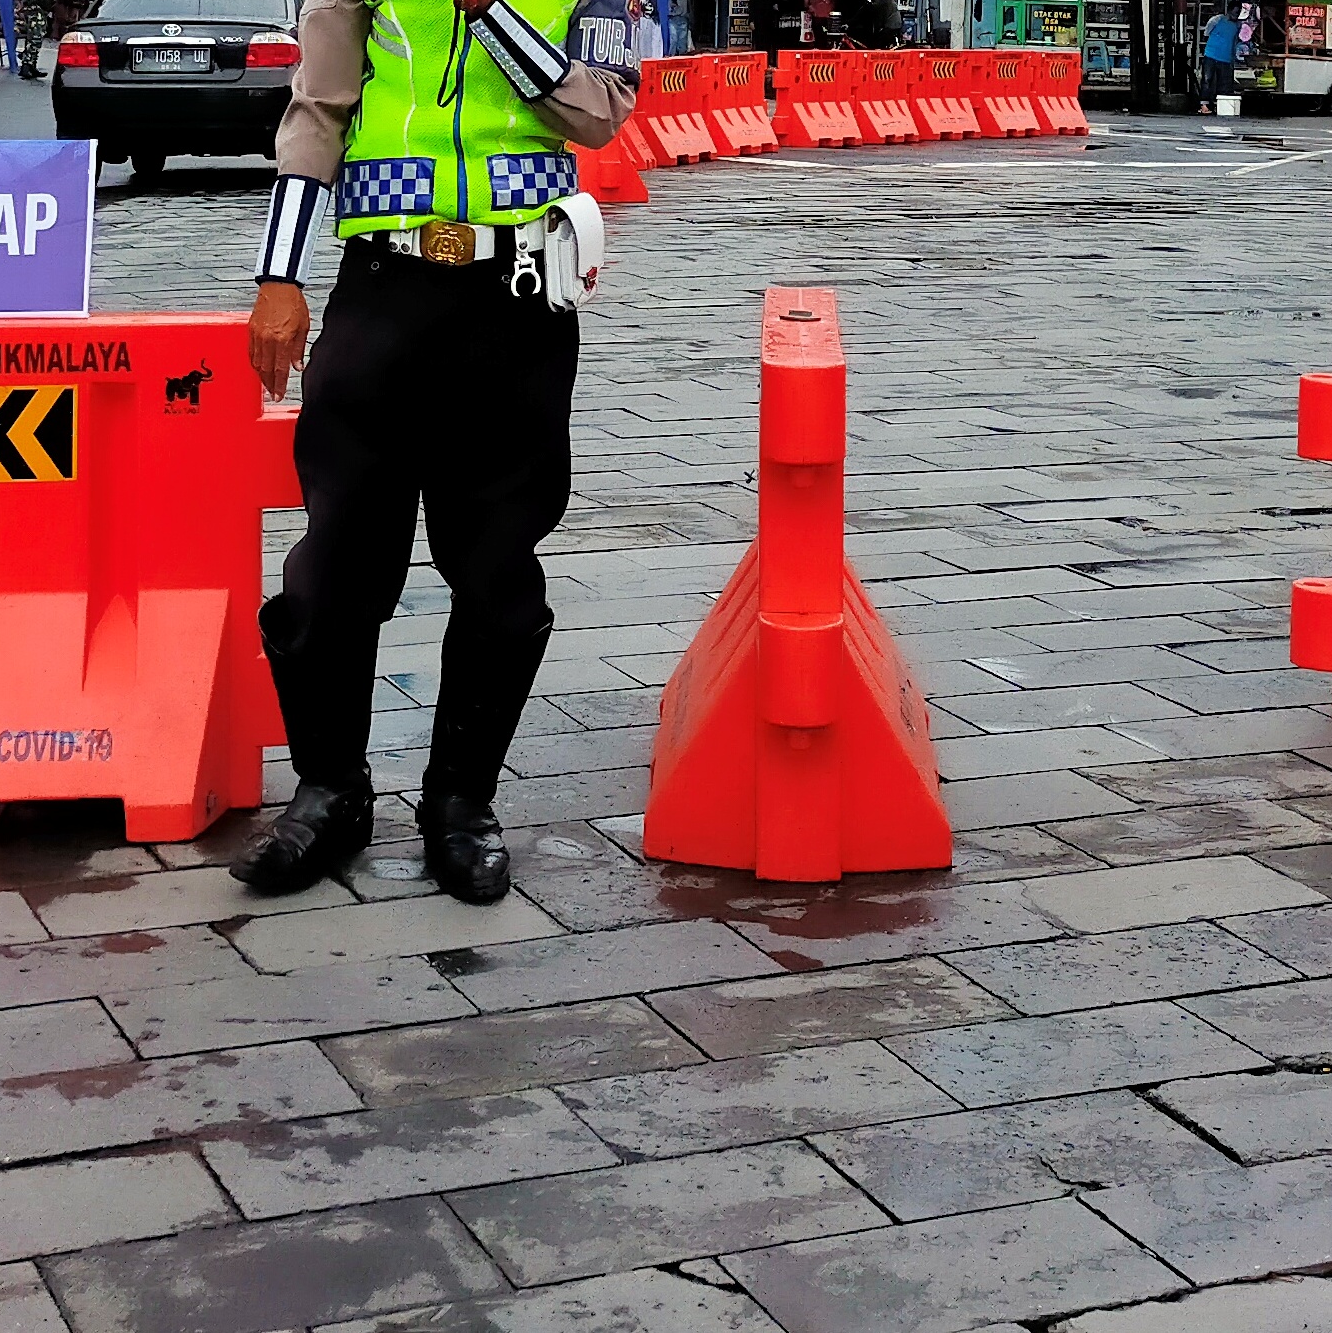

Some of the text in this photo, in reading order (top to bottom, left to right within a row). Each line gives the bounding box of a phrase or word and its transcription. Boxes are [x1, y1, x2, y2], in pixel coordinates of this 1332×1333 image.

[135, 50, 207, 63] D 1058 UL
